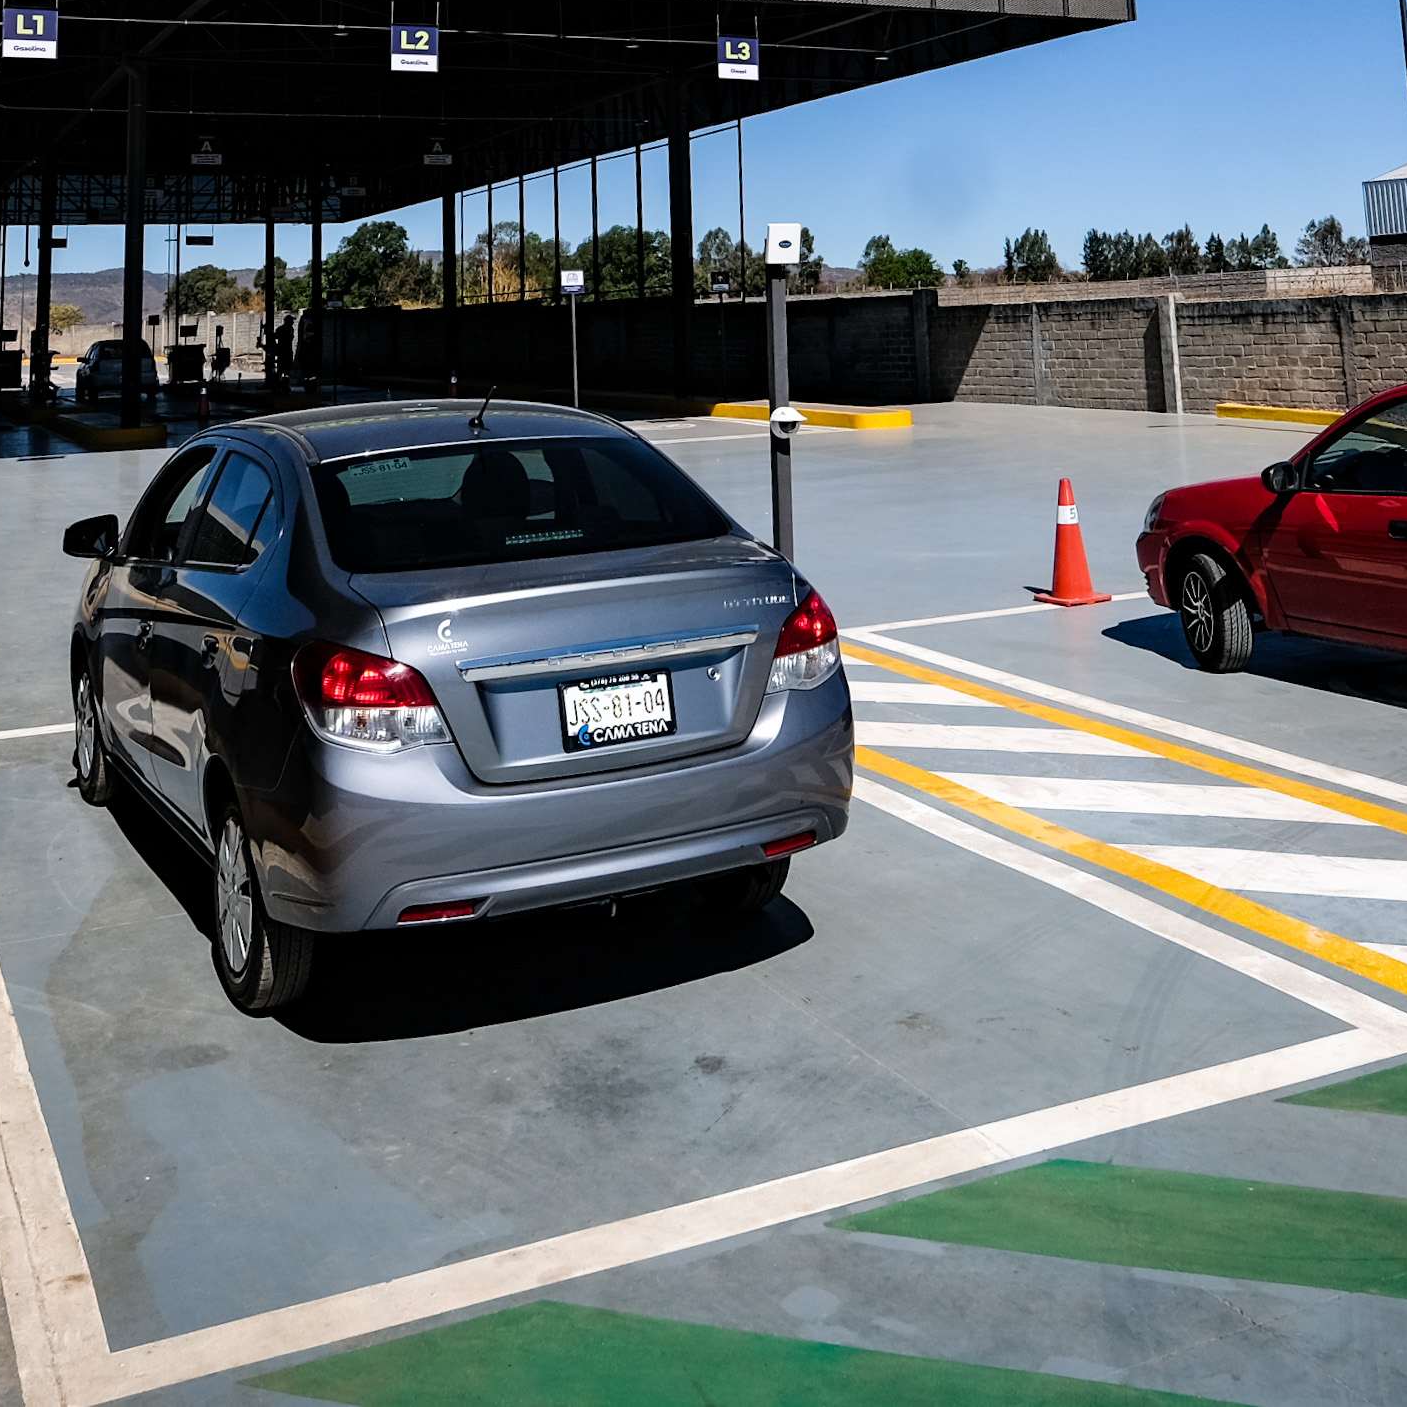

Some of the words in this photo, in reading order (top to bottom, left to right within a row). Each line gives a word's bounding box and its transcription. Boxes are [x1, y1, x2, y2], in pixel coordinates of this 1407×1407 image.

[16, 14, 45, 36] L1
[400, 30, 430, 51] L2
[725, 41, 751, 61] L3
[200, 140, 213, 152] A
[432, 142, 443, 153] A
[569, 688, 665, 726] JSS-81-04
[593, 719, 669, 743] CAMARENA
